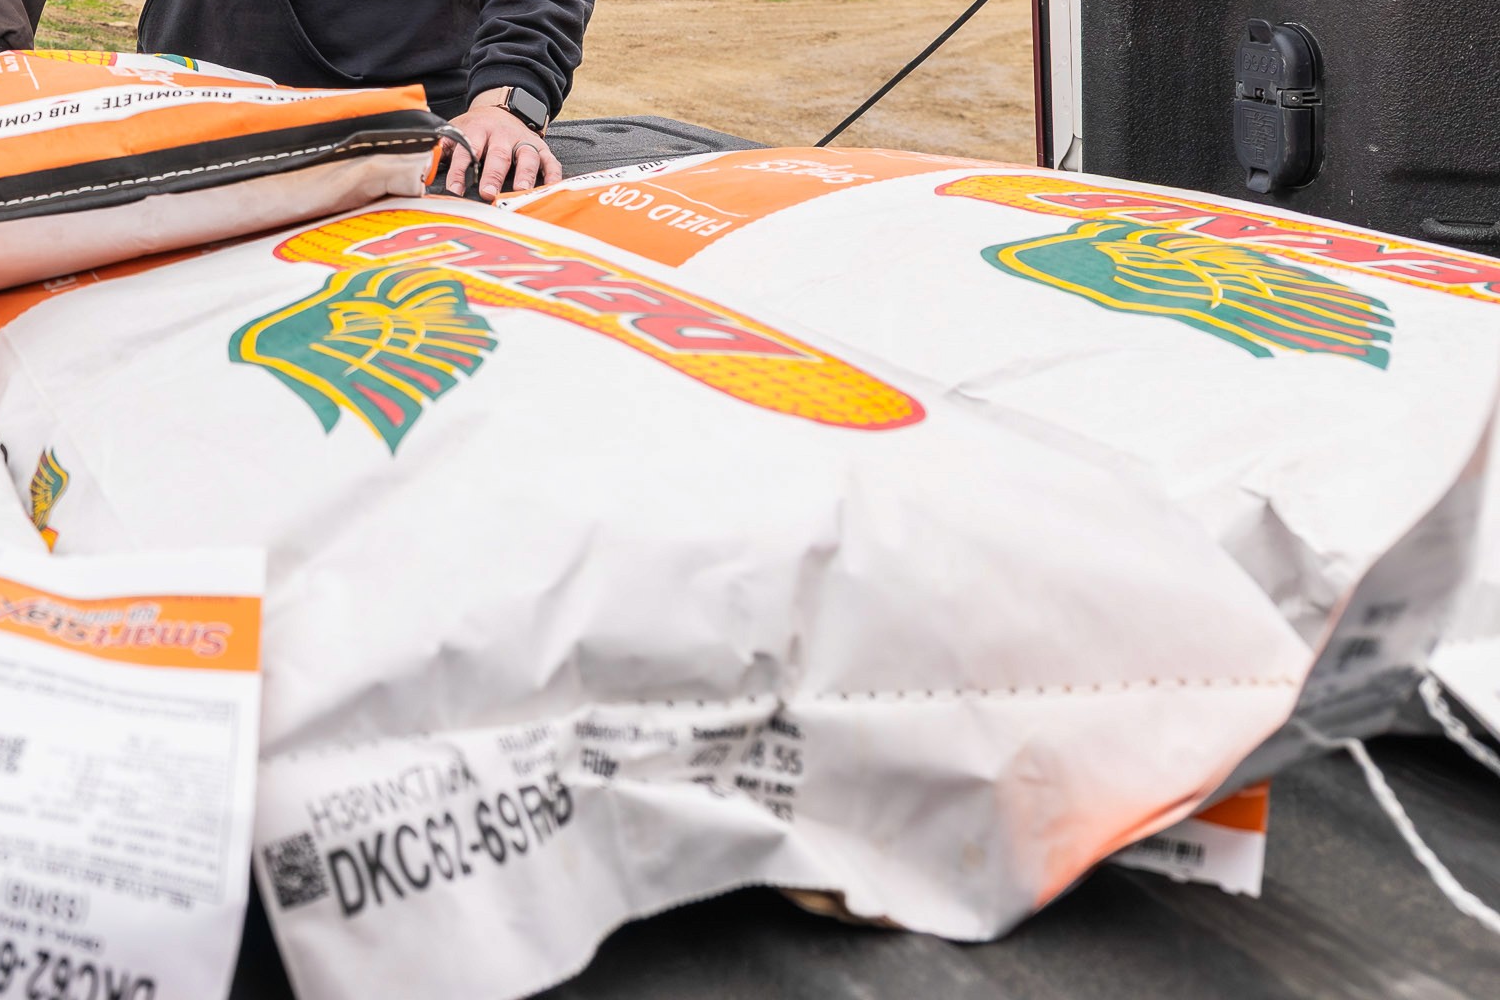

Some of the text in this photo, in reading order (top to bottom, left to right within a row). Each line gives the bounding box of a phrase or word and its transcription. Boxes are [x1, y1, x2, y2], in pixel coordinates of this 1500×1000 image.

[49, 103, 80, 118] RIB
[102, 90, 194, 109] COMPLETE
[587, 184, 733, 237] FIELD COR
[1035, 193, 1500, 297] EKALB
[350, 225, 817, 359] DEKALB
